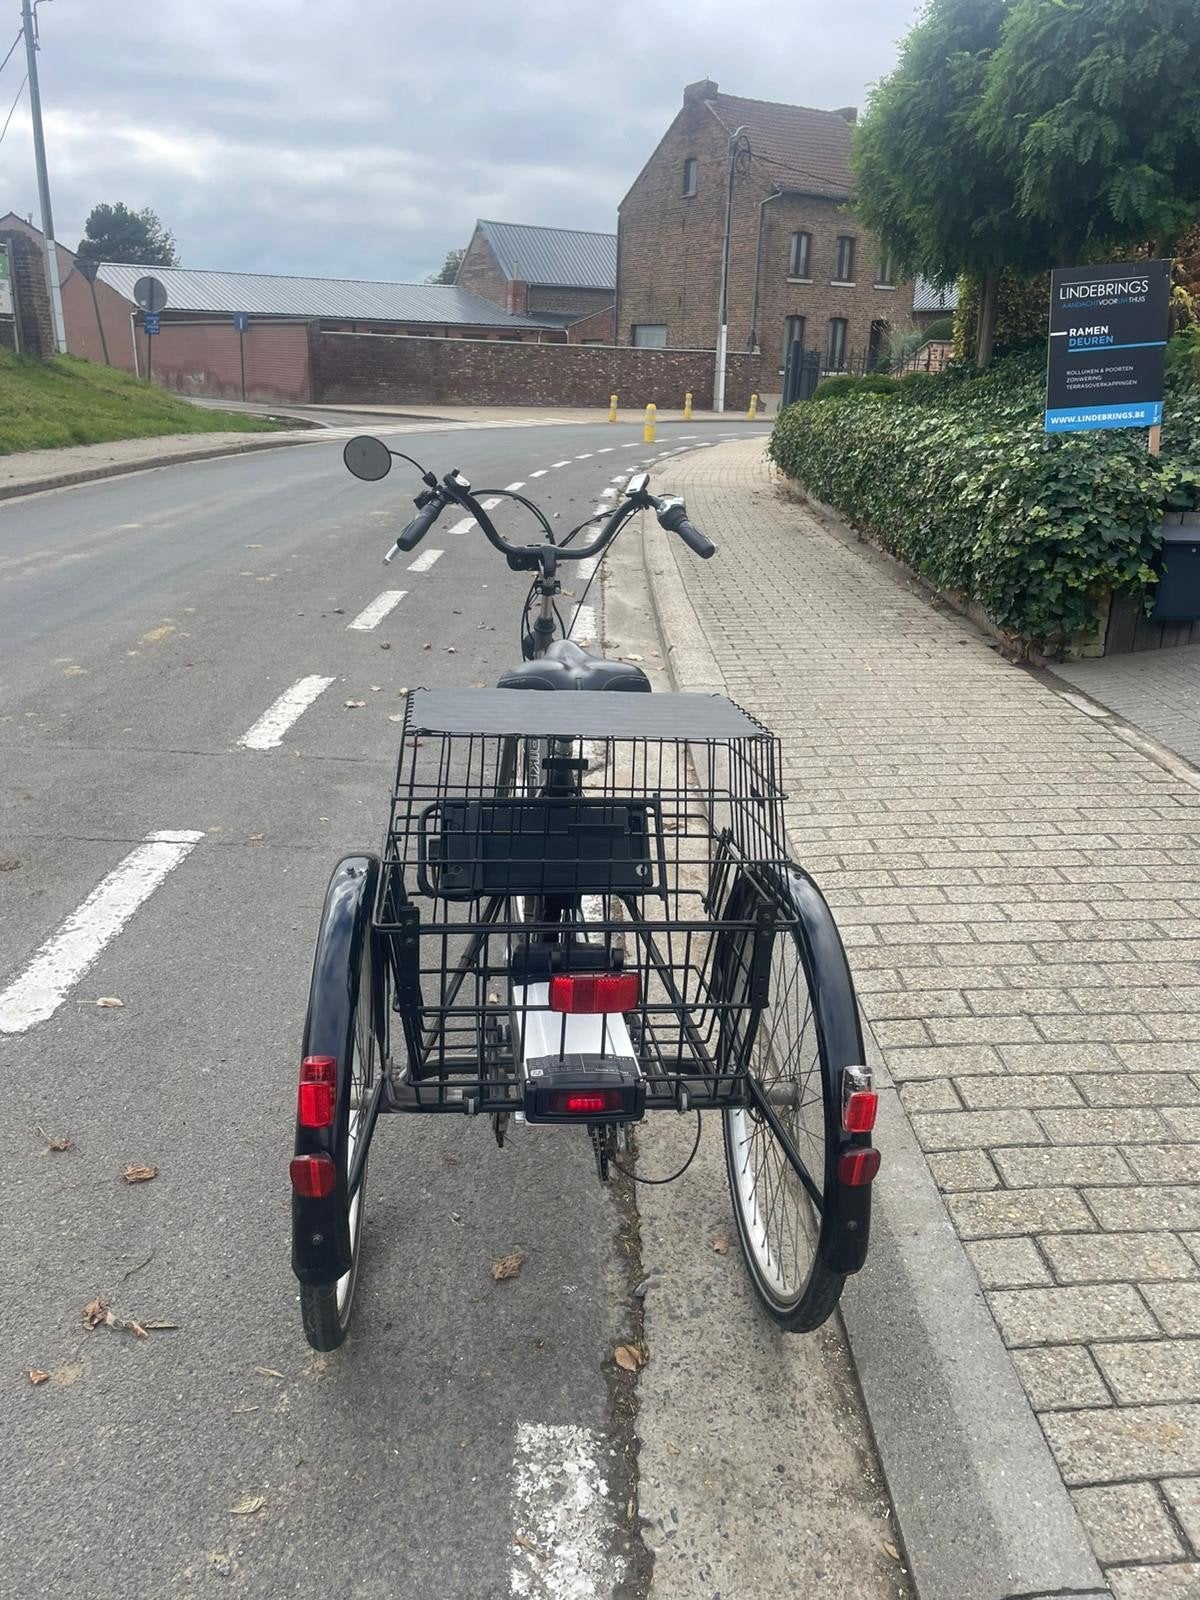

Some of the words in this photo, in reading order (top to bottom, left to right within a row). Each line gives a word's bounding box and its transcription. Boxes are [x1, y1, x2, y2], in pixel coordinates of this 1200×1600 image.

[1059, 279, 1149, 300] LINDEBRINGS
[1069, 325, 1109, 337] RAMEN
[1068, 335, 1114, 347] DEUREN
[1066, 367, 1099, 376] ROLLUIKEN
[1066, 375, 1102, 383] ZONWERING
[1066, 379, 1138, 390] TERRASOVERKAPPINGEN
[1050, 410, 1145, 425] WWW.LINDEBRINGS.BE
